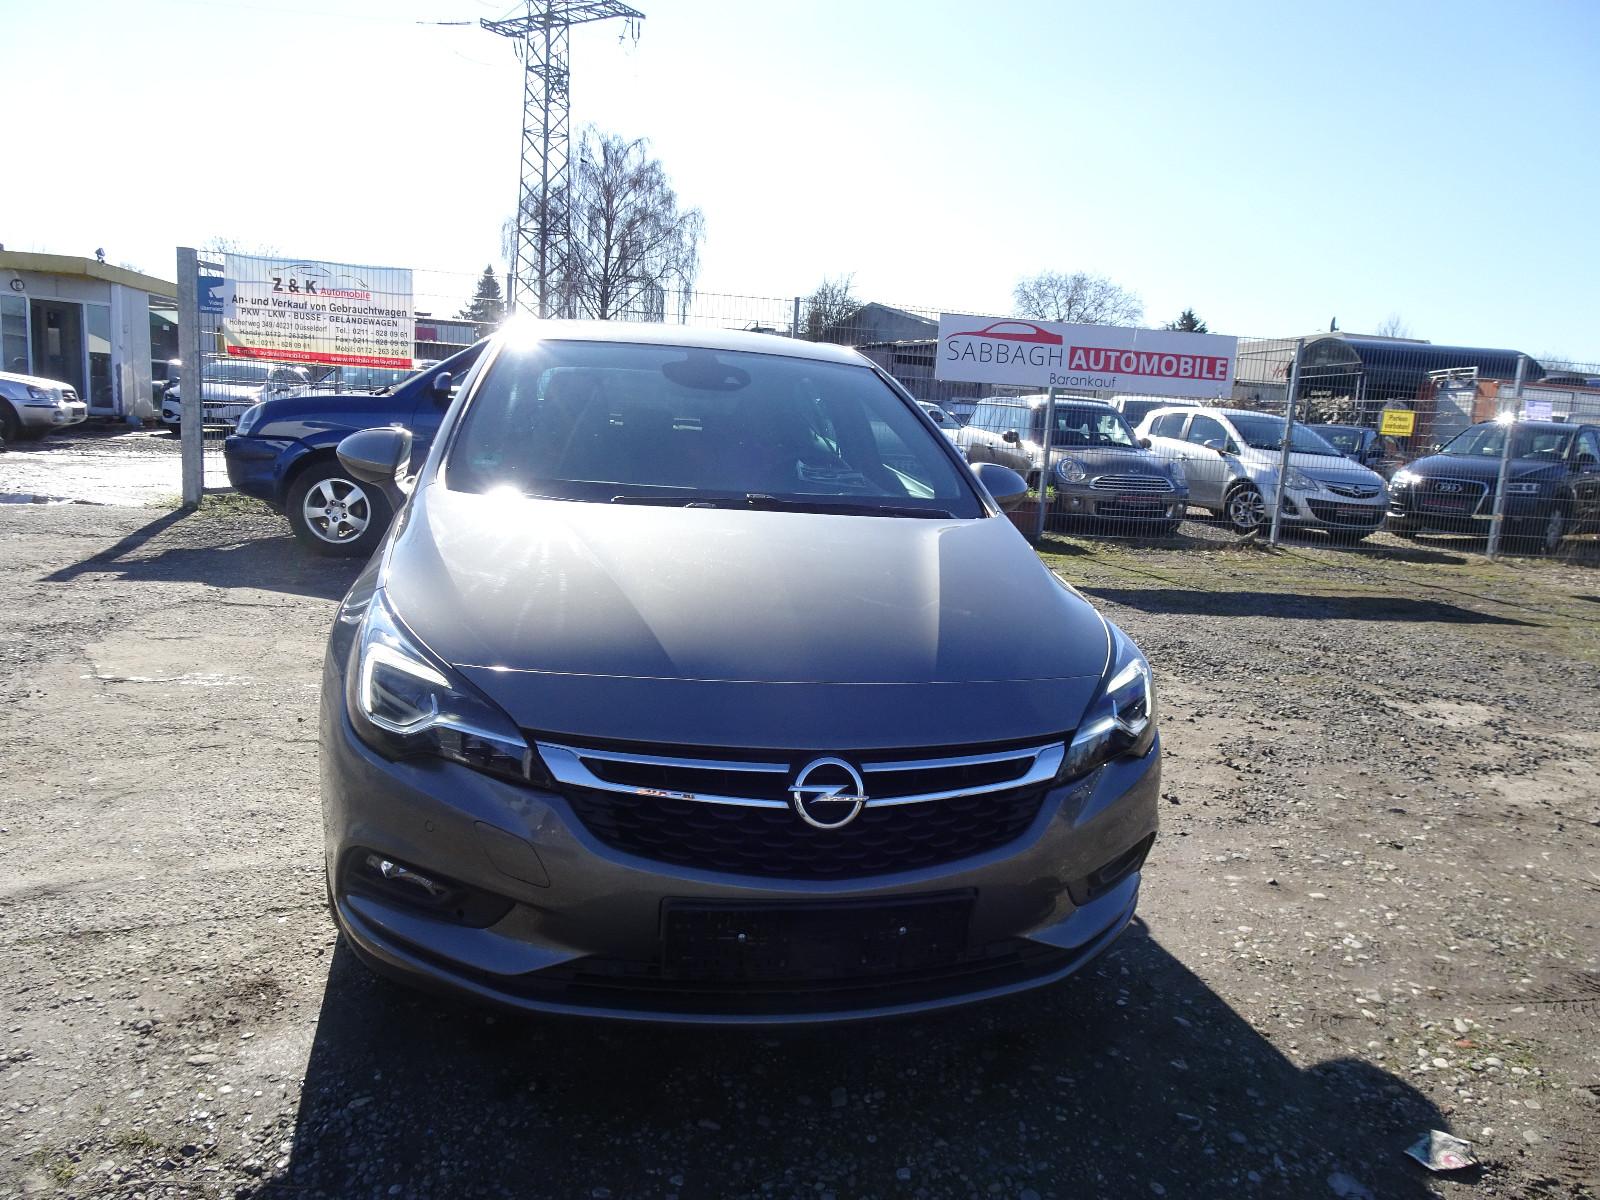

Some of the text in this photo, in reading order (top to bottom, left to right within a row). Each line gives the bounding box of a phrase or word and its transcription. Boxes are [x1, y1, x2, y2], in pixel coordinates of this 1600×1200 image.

[272, 277, 372, 299] Z & K Automobile
[231, 294, 407, 318] An- und Verkauf von Gebrauchtwagen
[241, 307, 260, 316] PKW
[267, 309, 286, 318] LKW
[293, 311, 321, 322] BUSSE
[948, 340, 1227, 380] SABBAGH AUTOMOBILE
[1050, 373, 1117, 388] Barankauf
